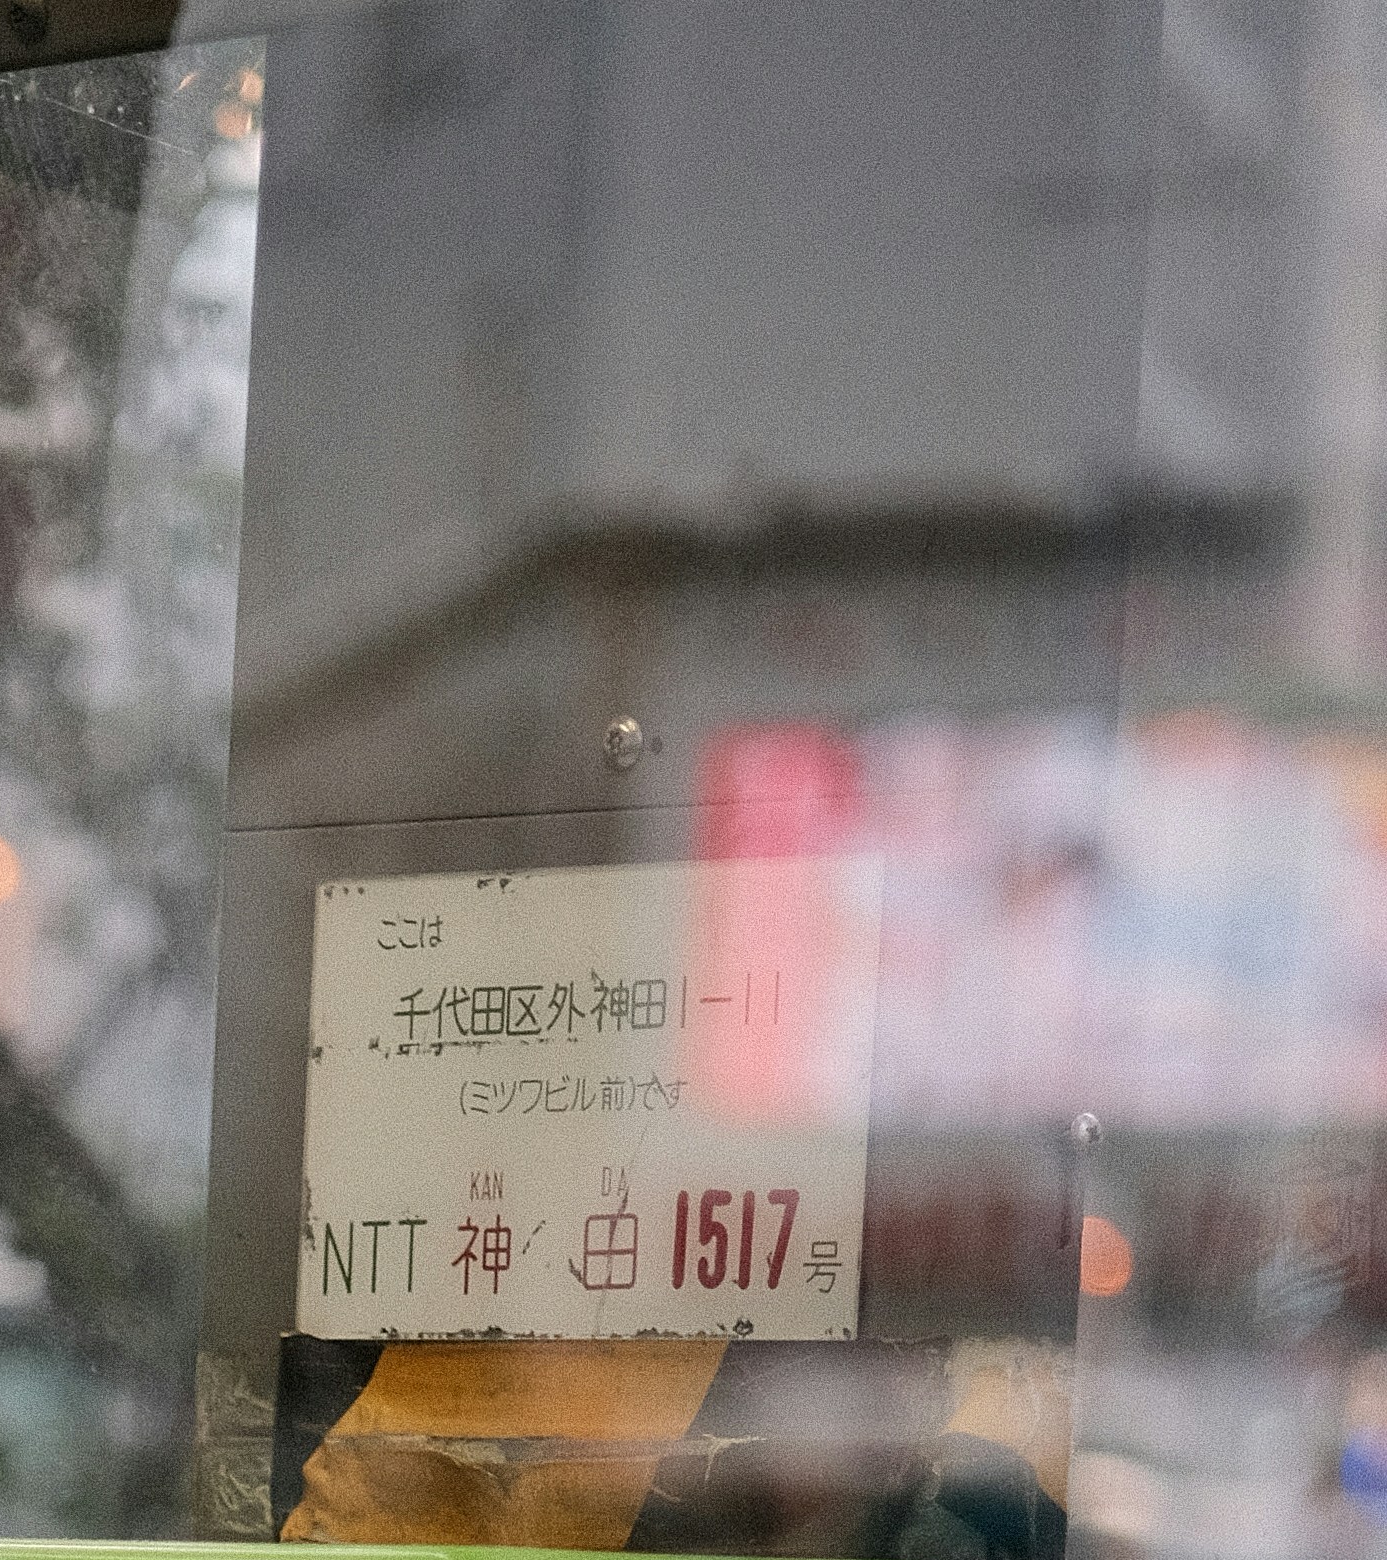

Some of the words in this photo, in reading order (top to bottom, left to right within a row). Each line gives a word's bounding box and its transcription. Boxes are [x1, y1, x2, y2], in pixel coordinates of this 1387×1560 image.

[377, 914, 444, 950] ここは
[469, 1171, 505, 1202] KAN
[323, 1218, 428, 1296] NTT
[452, 1213, 512, 1295] 神
[581, 1212, 639, 1292] 田
[671, 1188, 802, 1292] 1517
[802, 1240, 844, 1294] 号
